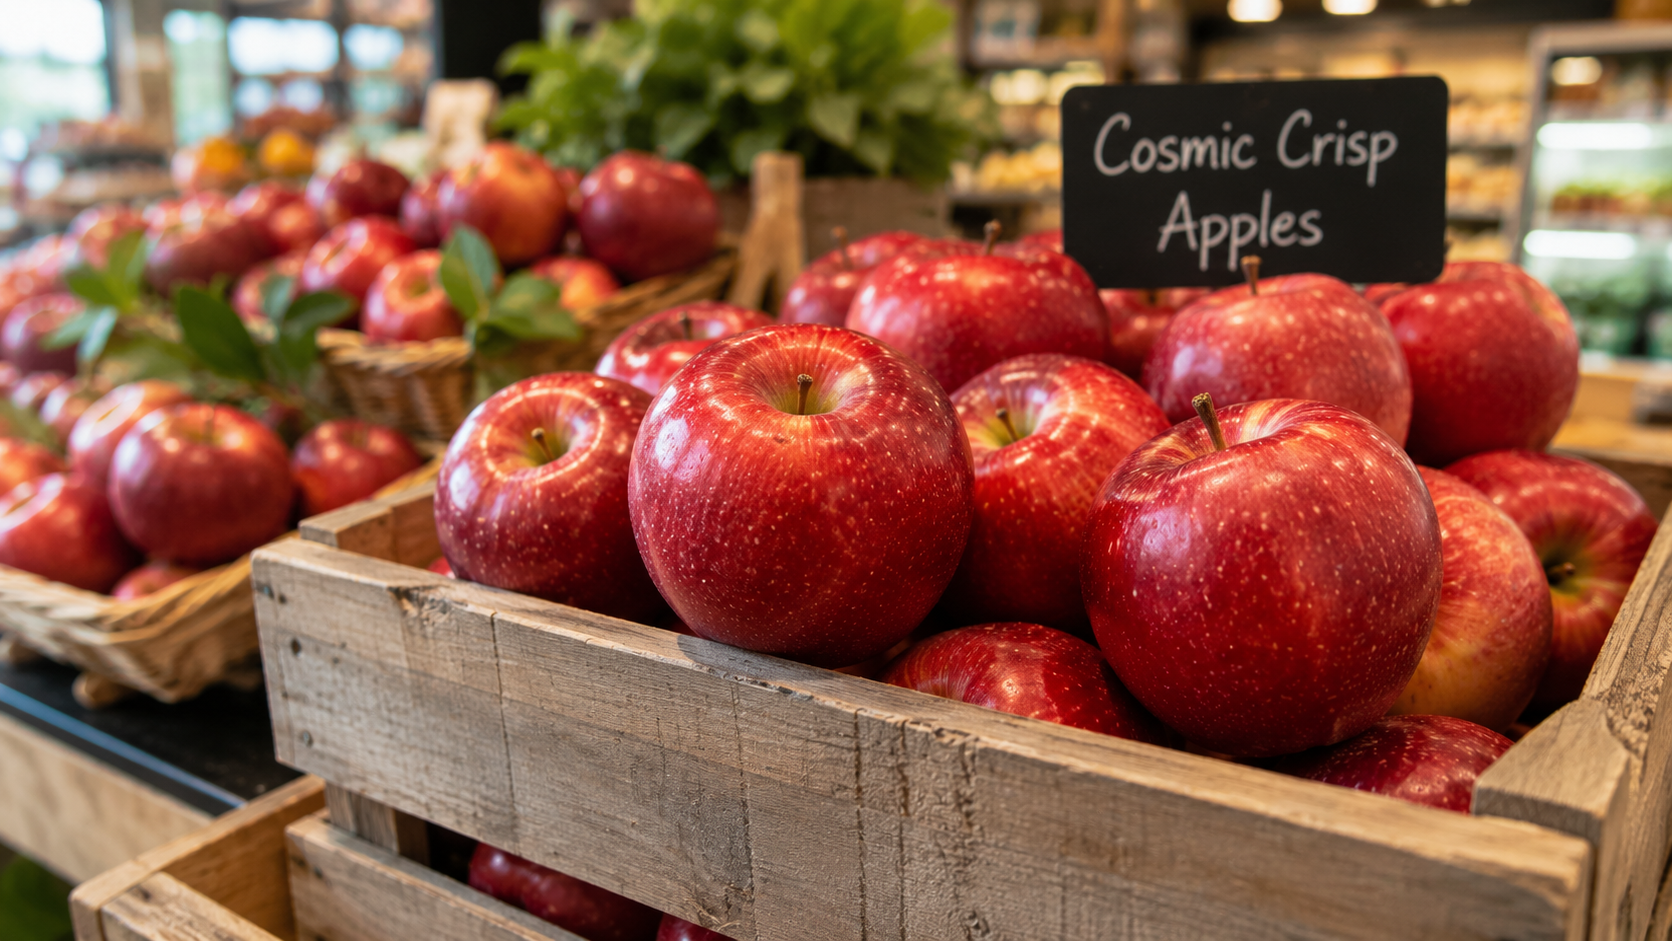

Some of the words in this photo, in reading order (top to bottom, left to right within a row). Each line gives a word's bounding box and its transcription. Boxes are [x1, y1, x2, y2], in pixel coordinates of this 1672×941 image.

[1094, 112, 1257, 176] Cosmic
[1277, 109, 1398, 187] Crisp
[1156, 188, 1324, 271] Apples
